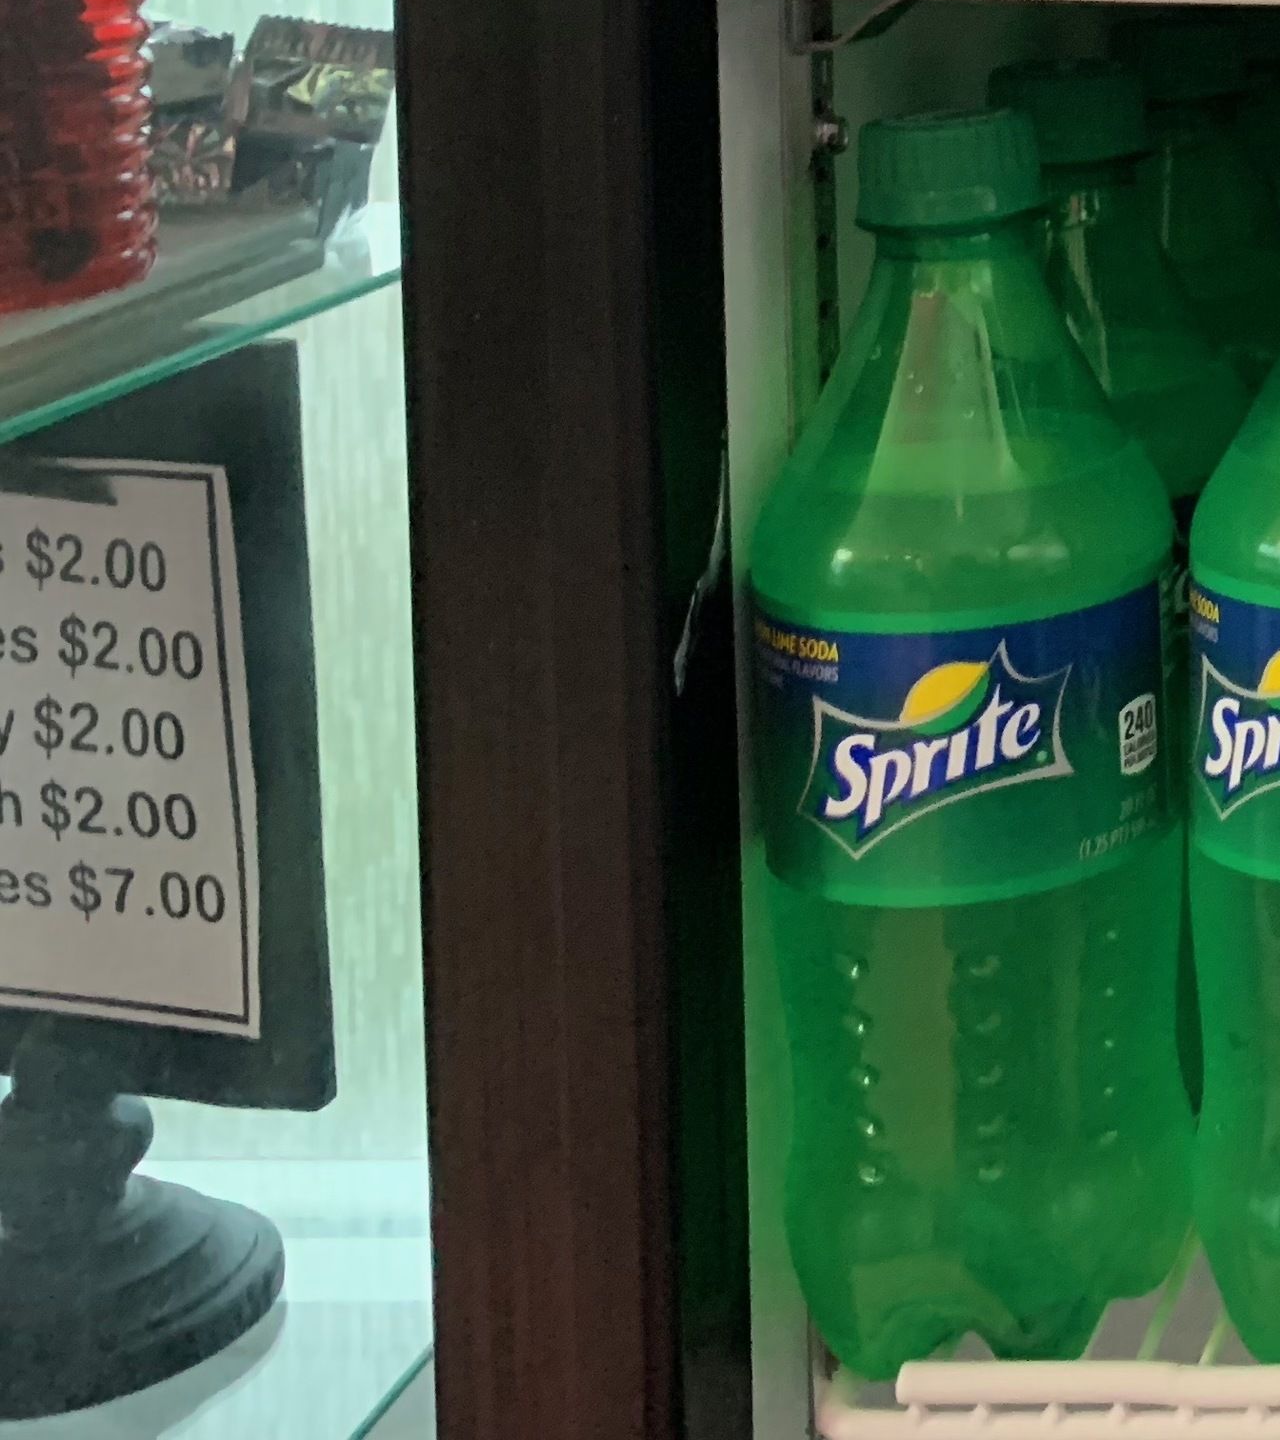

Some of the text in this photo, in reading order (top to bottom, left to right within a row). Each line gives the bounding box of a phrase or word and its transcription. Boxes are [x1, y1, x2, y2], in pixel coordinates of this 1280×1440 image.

[26, 525, 166, 592] $2.00
[58, 612, 203, 680] $2.00
[799, 636, 839, 663] SODA
[33, 693, 185, 760] $2.00
[1124, 700, 1154, 740] 240
[824, 684, 1041, 828] Sprite
[40, 778, 197, 842] $2.00
[68, 859, 226, 923] $7.00
